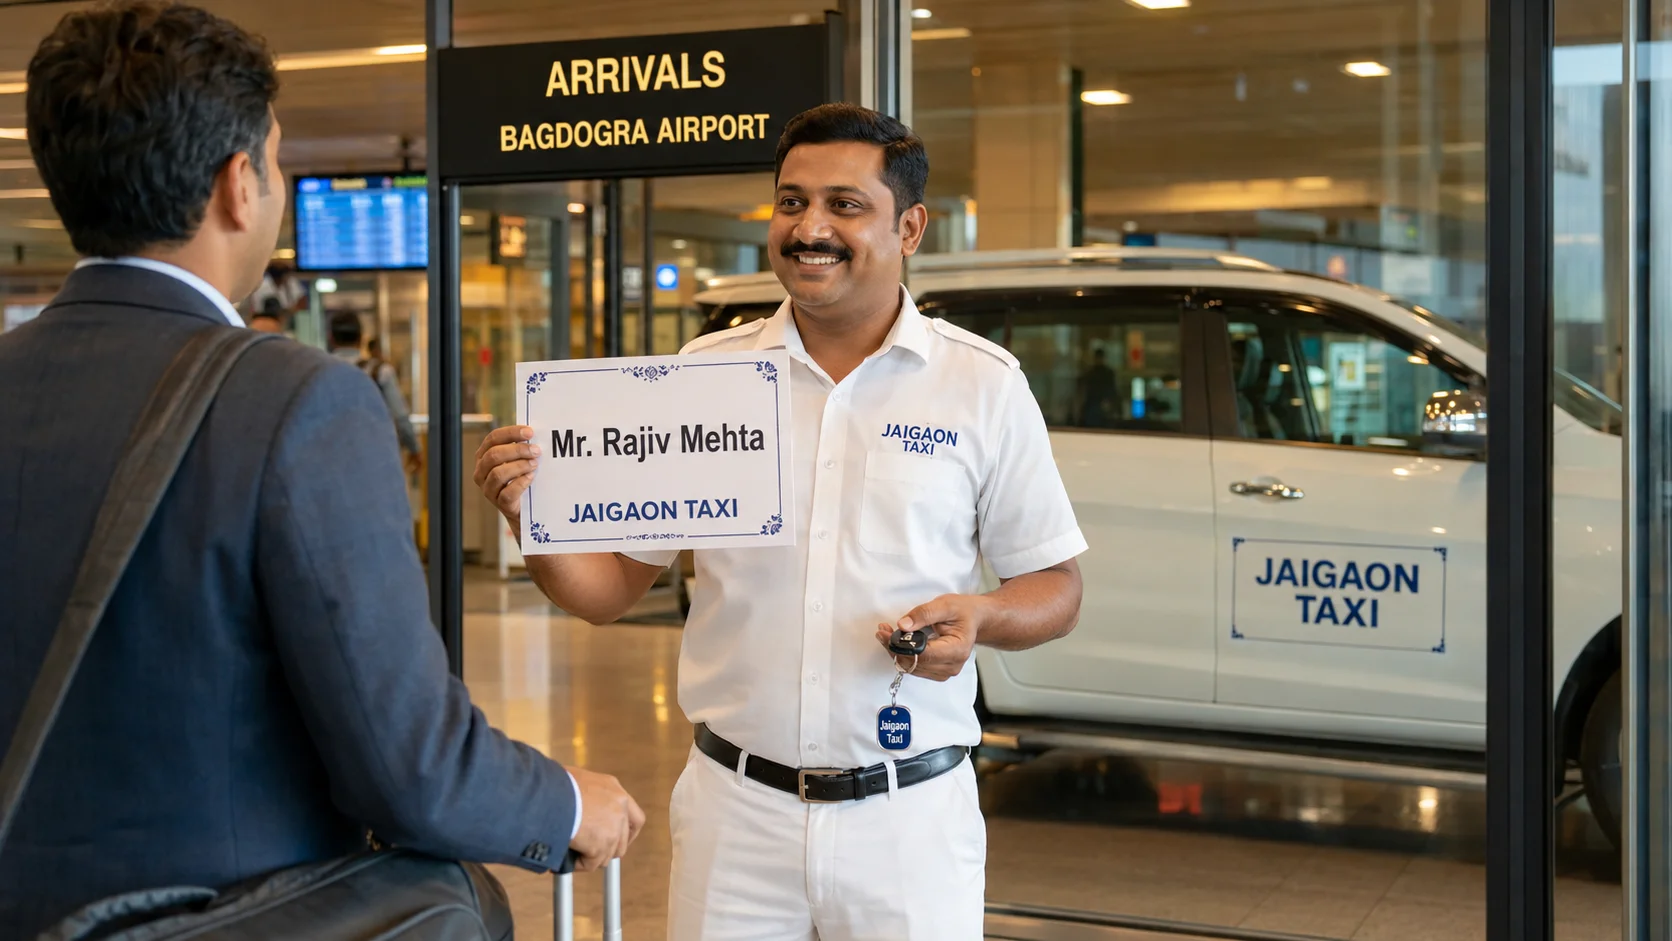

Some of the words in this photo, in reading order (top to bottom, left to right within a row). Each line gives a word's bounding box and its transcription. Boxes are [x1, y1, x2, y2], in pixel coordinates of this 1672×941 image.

[545, 50, 726, 97] ARRIVALS
[500, 118, 650, 152] BAGDOGRA
[656, 113, 770, 144] AIRPORT
[551, 429, 592, 458] Mr.
[602, 426, 671, 463] Rajiv
[680, 423, 765, 454] Mehta
[881, 423, 958, 447] JAIGAON
[902, 440, 935, 455] TAXI
[568, 501, 678, 524] JAIGAON
[684, 498, 738, 519] TAXI
[1255, 556, 1420, 594] JAIGAON
[1295, 594, 1380, 629] TAXI
[880, 720, 909, 733] Jaigaon
